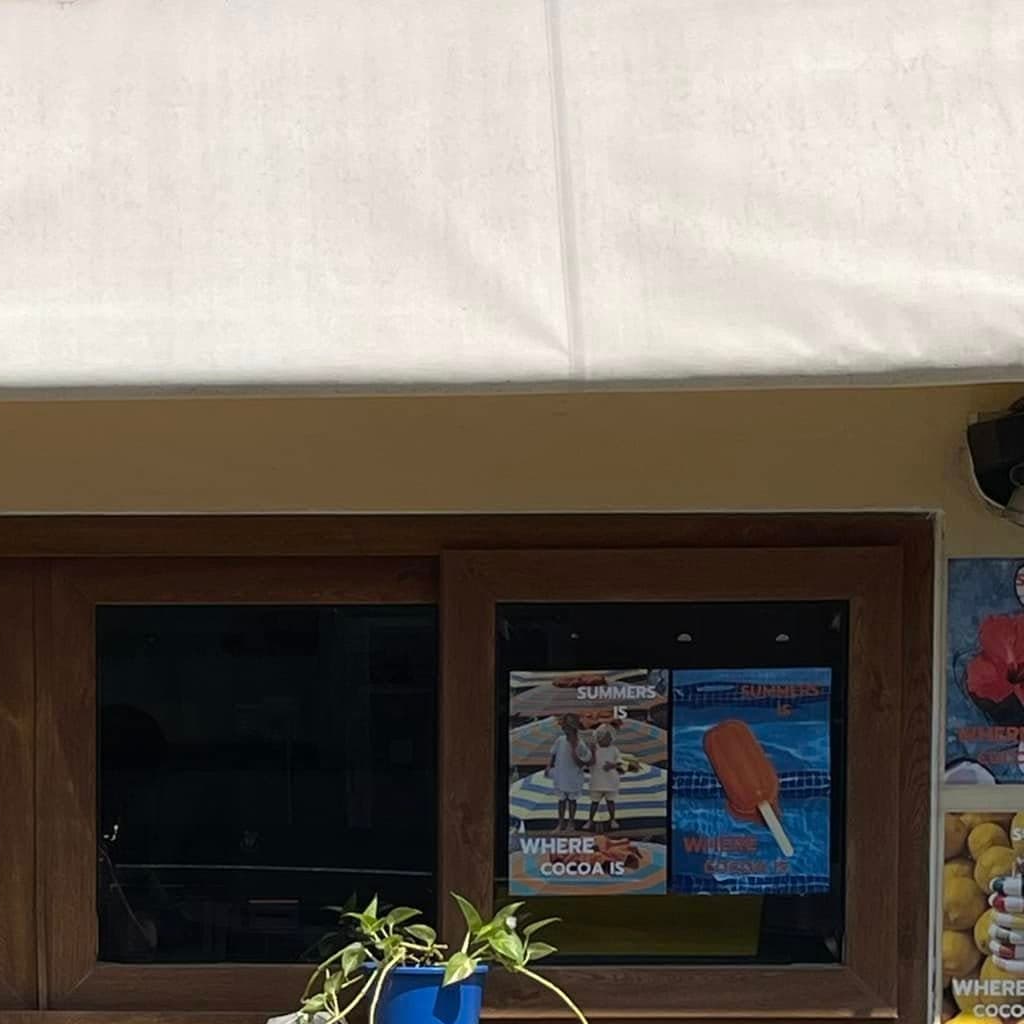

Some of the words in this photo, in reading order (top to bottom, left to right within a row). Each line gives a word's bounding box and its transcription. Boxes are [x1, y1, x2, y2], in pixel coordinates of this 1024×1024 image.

[577, 686, 656, 699] SUMMERS
[741, 685, 820, 697] SUMMERS
[613, 706, 627, 720] IS
[520, 838, 595, 854] WHERE
[540, 862, 605, 876] COCOA
[610, 861, 625, 876] IS
